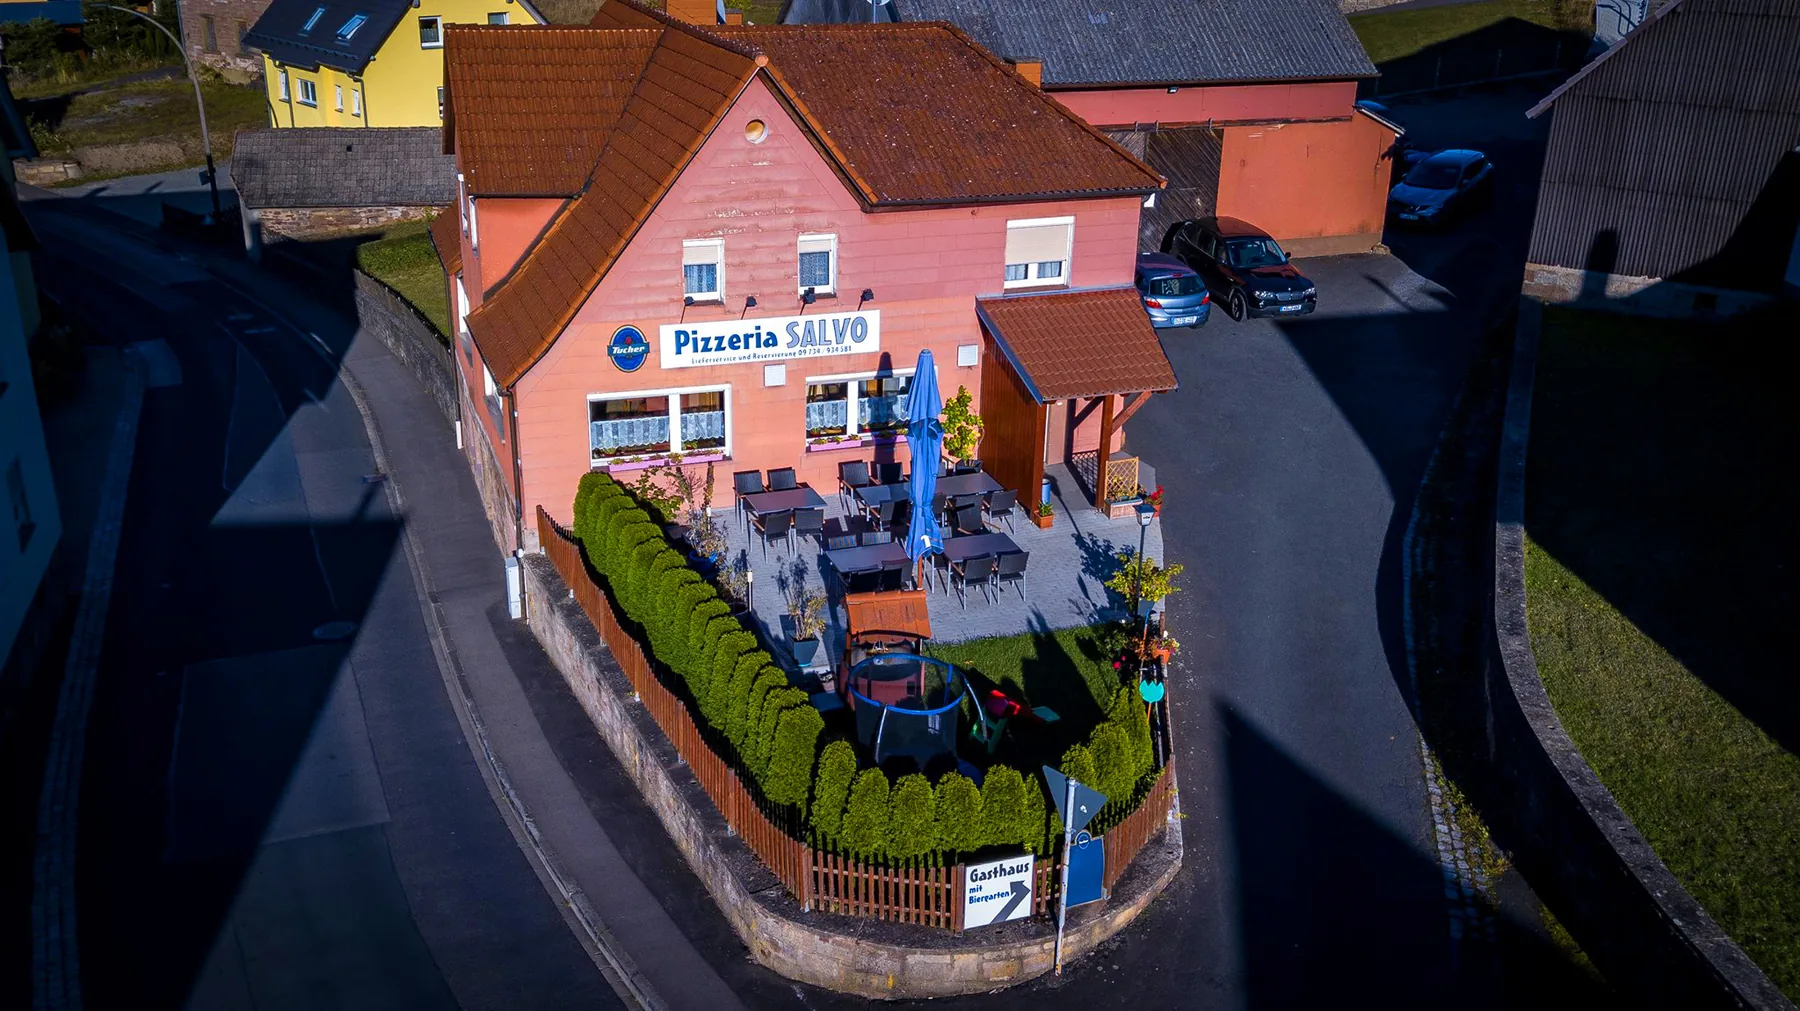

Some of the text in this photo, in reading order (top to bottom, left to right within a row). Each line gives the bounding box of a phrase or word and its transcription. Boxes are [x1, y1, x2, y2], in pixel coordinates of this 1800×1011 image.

[675, 317, 868, 355] Pizzeria SALVO
[612, 346, 645, 354] Tucher
[970, 862, 1030, 883] Gasthaus
[969, 885, 983, 894] mit
[968, 891, 1010, 904] Biergarten
